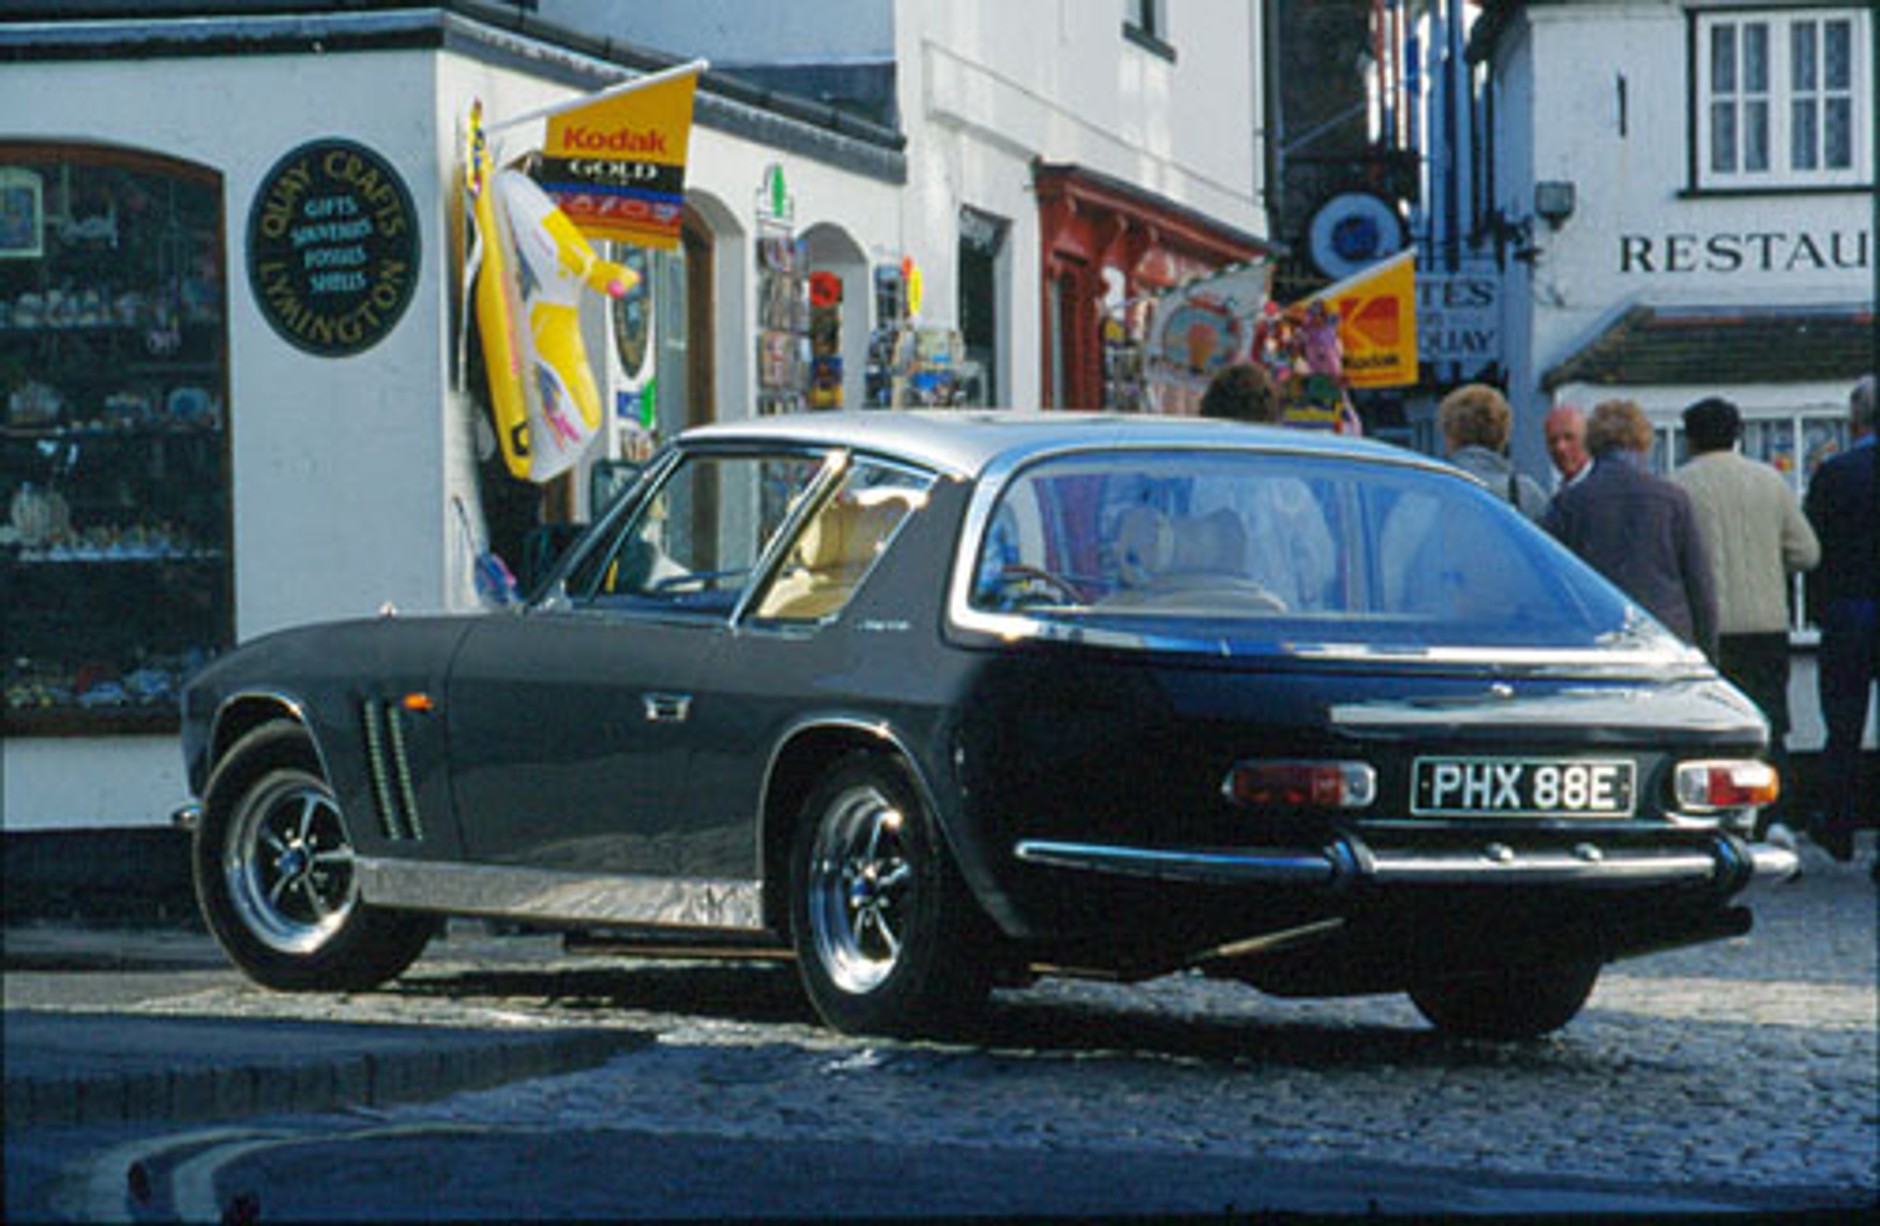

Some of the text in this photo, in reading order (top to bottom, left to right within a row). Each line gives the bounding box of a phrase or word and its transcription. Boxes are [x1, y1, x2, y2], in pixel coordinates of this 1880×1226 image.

[563, 126, 667, 153] Kodak
[569, 159, 659, 179] GOLD
[261, 151, 405, 238] QUAY CRAFTS
[304, 196, 358, 216] GIFTS
[1617, 230, 1868, 273] RESTAU
[258, 259, 405, 346] LYMINGTON
[1432, 764, 1619, 810] PHX 88E
